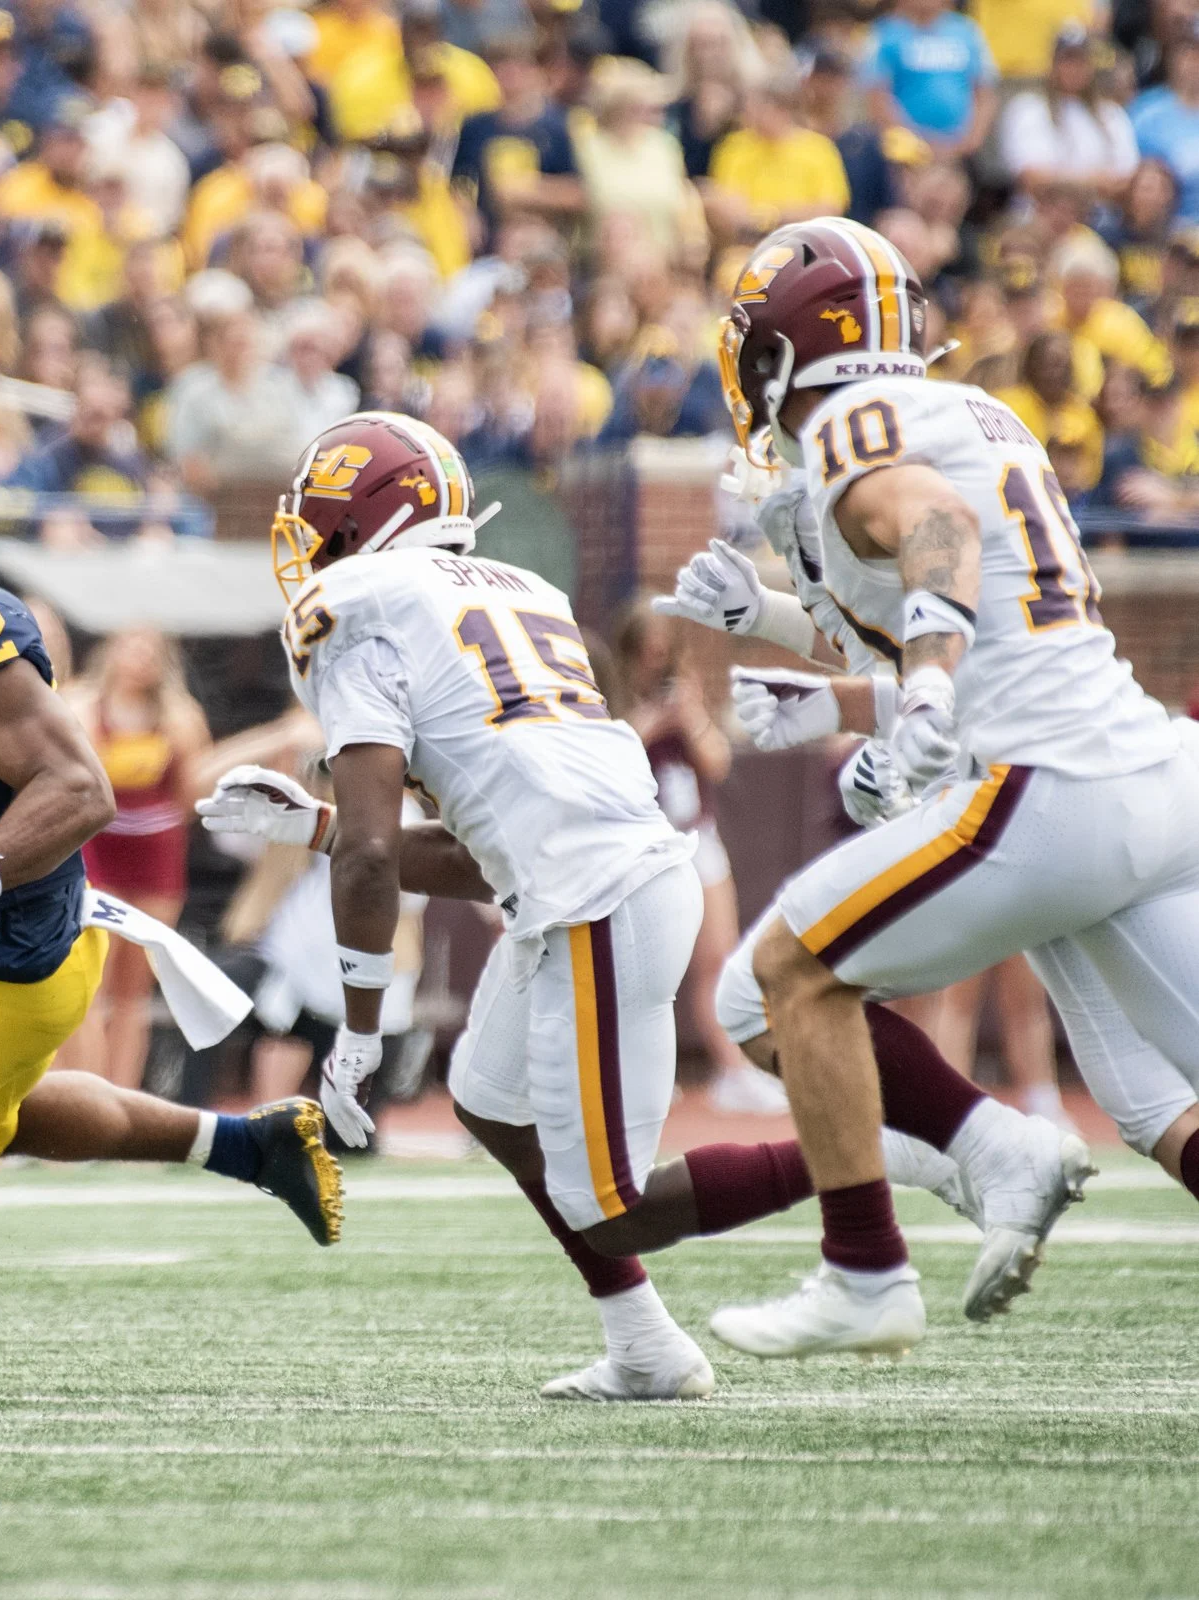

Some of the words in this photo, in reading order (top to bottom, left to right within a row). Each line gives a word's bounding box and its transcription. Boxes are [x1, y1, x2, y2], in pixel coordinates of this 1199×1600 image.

[814, 397, 904, 488] 10
[431, 559, 535, 594] SPANN
[452, 605, 613, 731] 15
